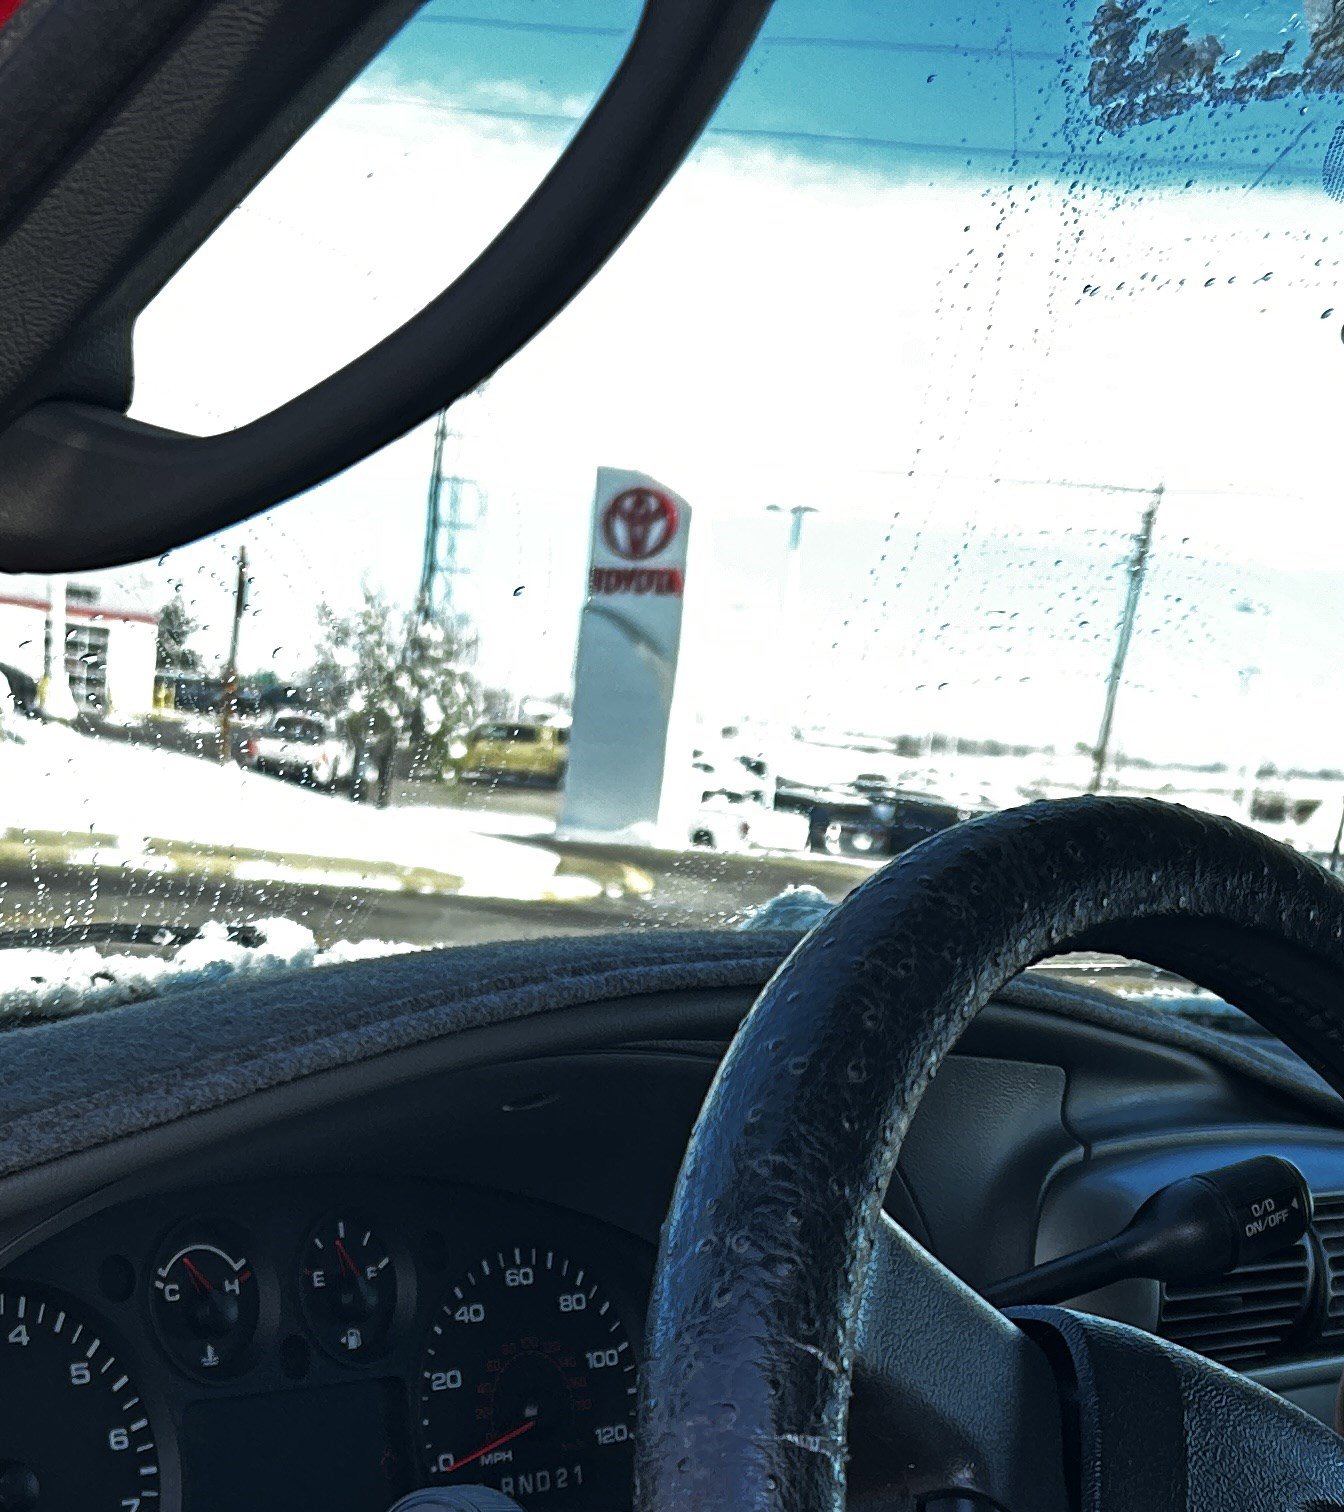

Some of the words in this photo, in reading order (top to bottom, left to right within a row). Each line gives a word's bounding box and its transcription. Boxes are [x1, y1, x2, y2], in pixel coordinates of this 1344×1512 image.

[1245, 1208, 1289, 1238] ON/OFF
[224, 1278, 240, 1296] H
[312, 1270, 326, 1289] E
[504, 1267, 535, 1288] 60
[163, 1284, 181, 1303] C
[558, 1293, 587, 1313] 80
[453, 1303, 486, 1324] 40
[7, 1324, 31, 1347] 4
[584, 1349, 619, 1369] 100
[69, 1361, 92, 1386] 5
[430, 1369, 463, 1392] 20
[108, 1427, 130, 1452] 6
[594, 1424, 629, 1446] 120
[437, 1453, 455, 1472] 0
[479, 1449, 514, 1467] MPH
